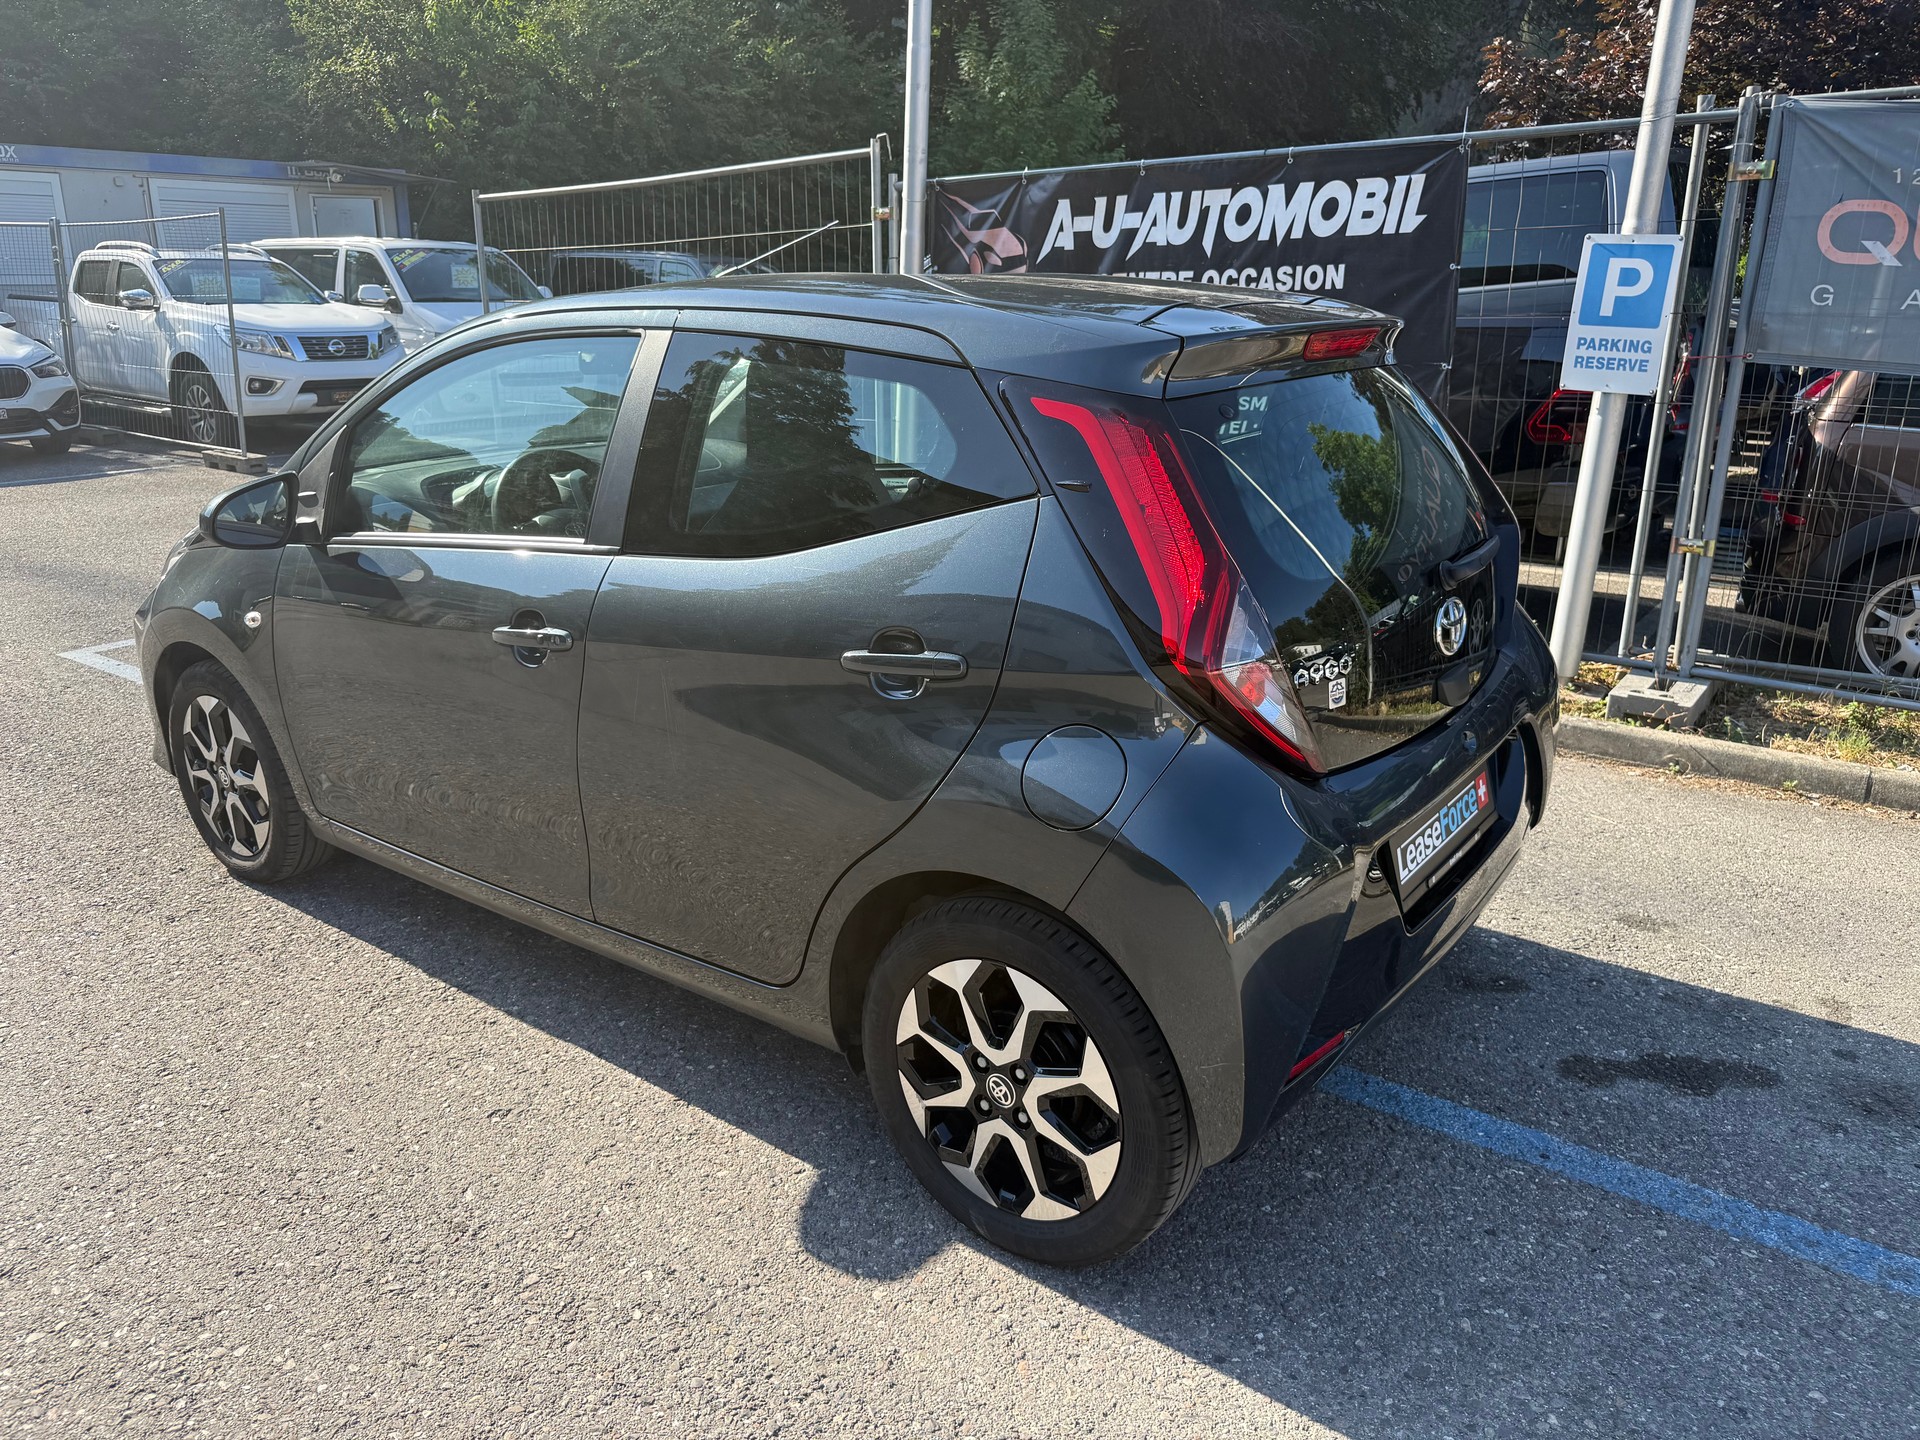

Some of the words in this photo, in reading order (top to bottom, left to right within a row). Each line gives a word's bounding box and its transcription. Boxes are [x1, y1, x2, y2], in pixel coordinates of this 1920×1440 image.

[1036, 172, 1428, 264] A-U-AUTOMOBIL
[1816, 199, 1920, 268] Q
[1201, 263, 1346, 292] OCCASION
[1600, 257, 1654, 317] P
[1575, 336, 1653, 355] PARKING
[1573, 354, 1650, 374] RESERVE
[1238, 395, 1268, 412] SM
[1293, 653, 1353, 689] AYGO
[1396, 787, 1478, 880] LeaseForce
